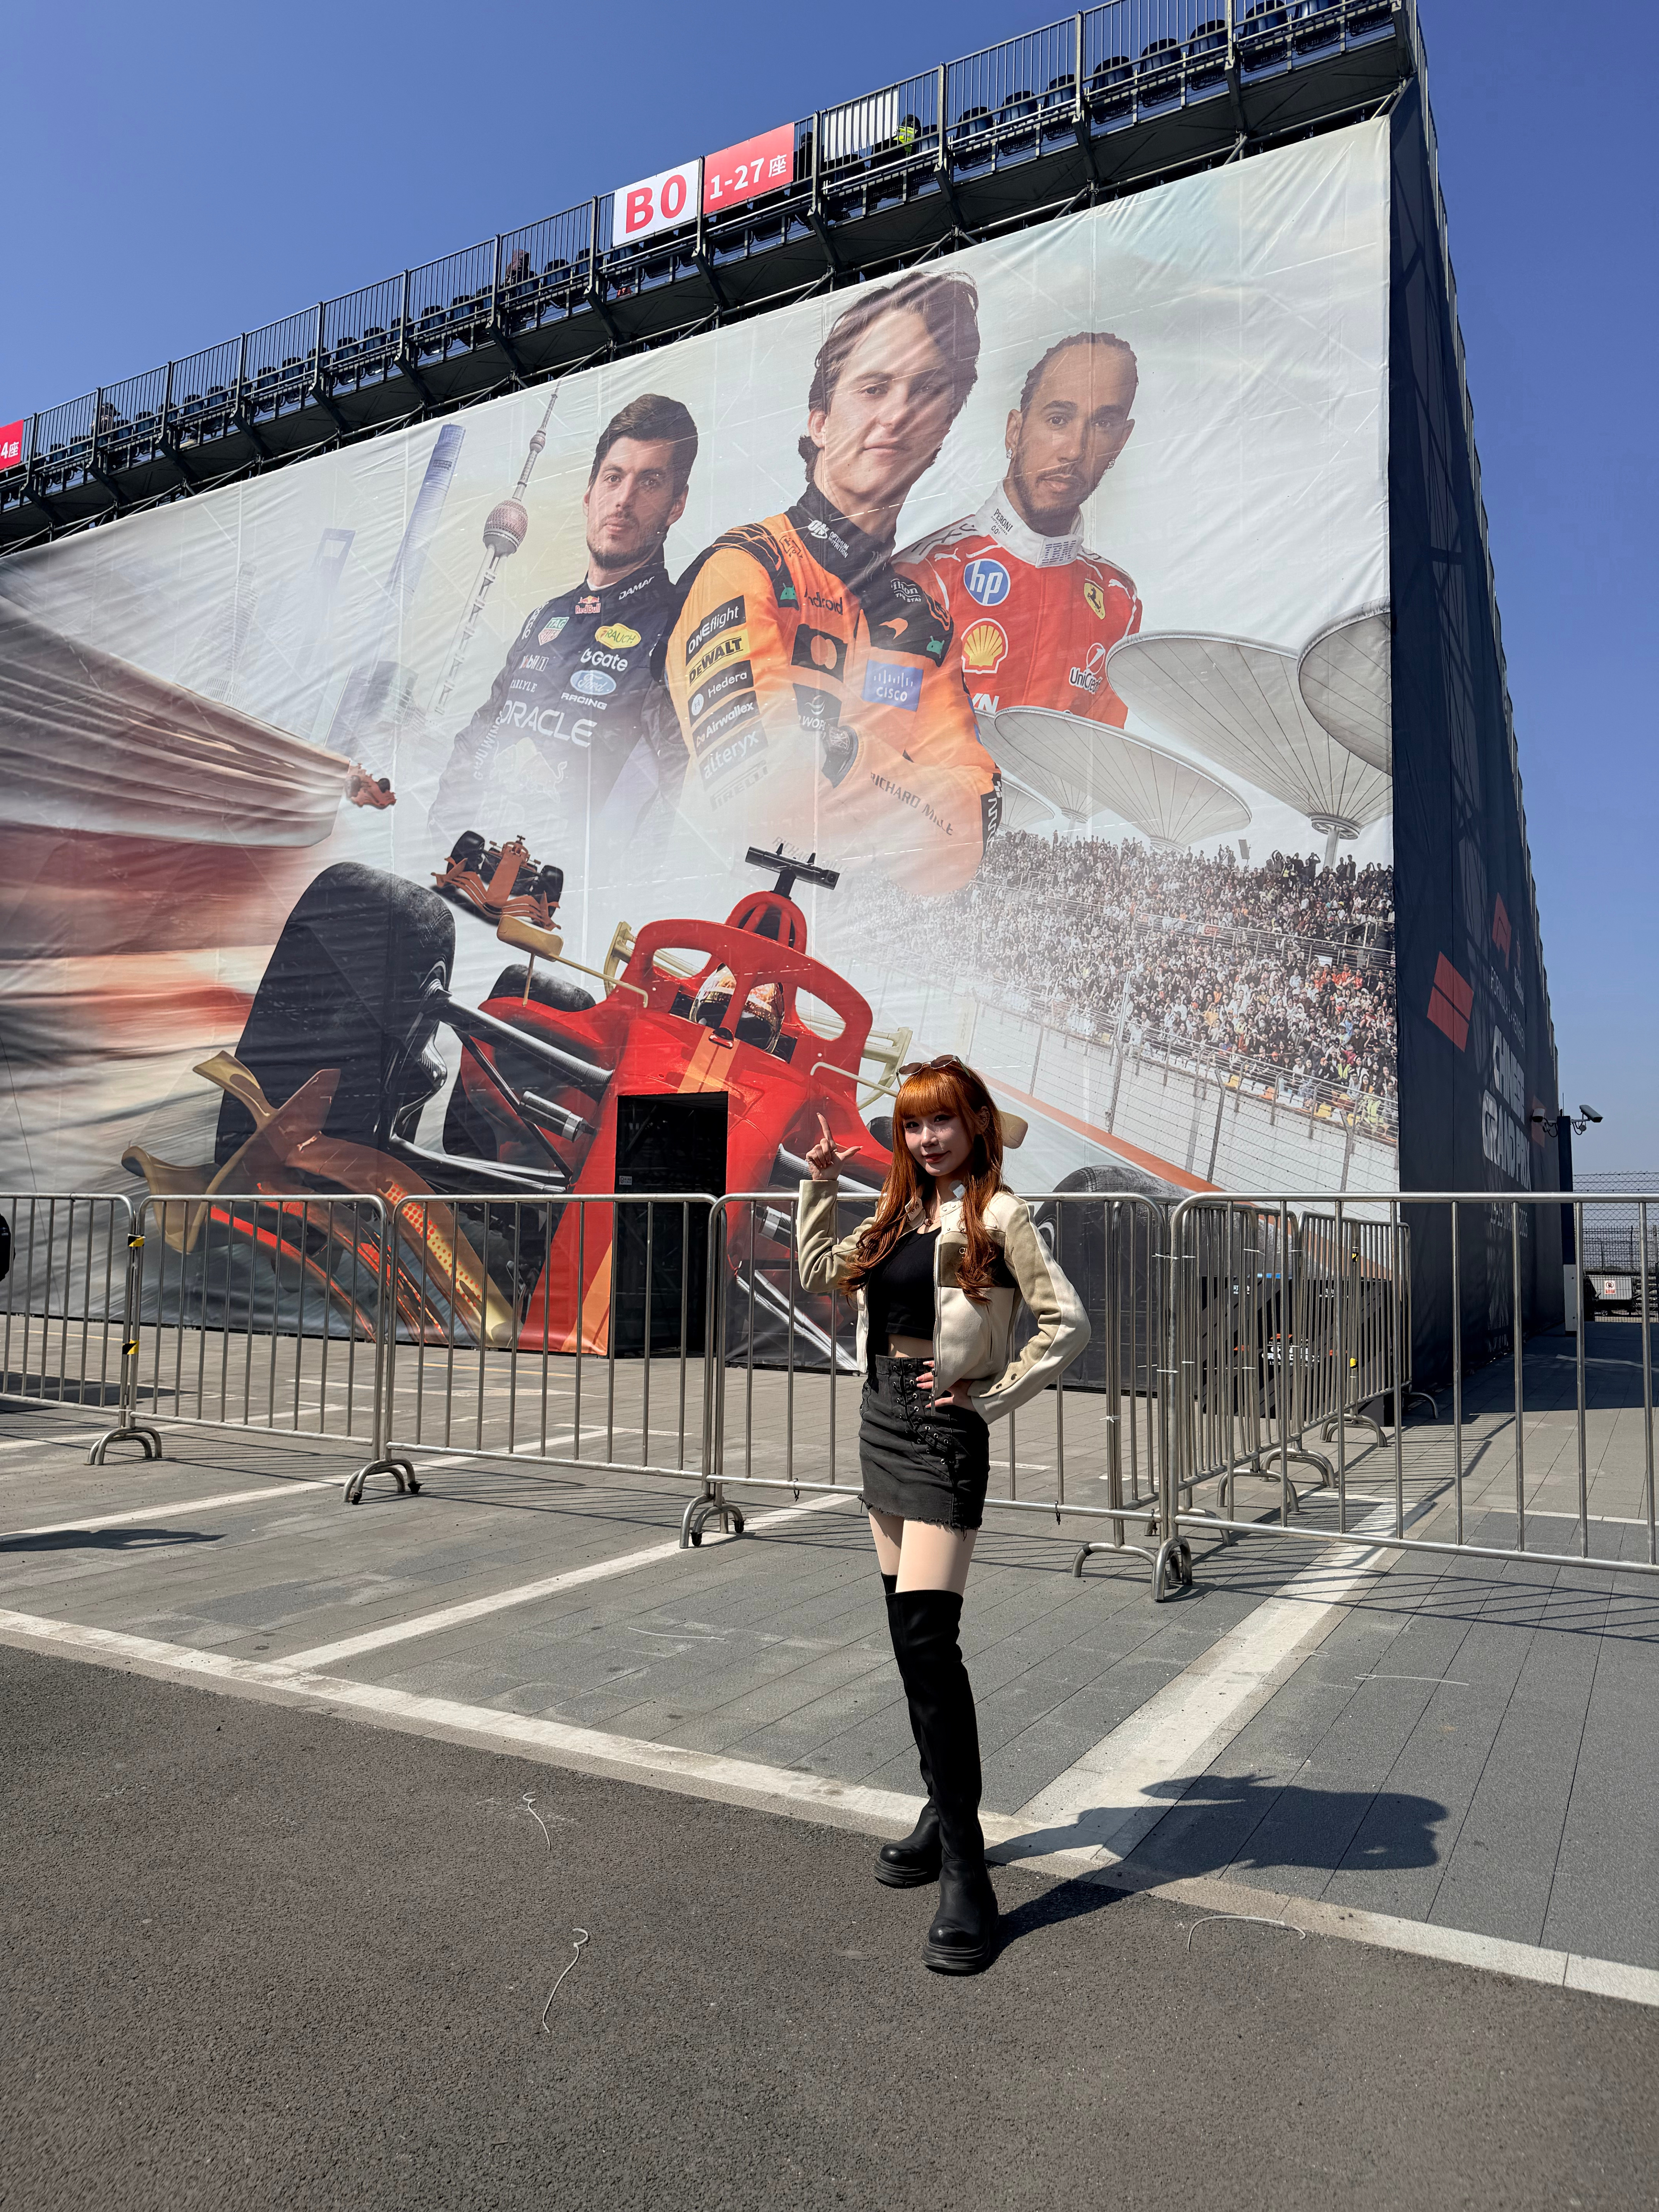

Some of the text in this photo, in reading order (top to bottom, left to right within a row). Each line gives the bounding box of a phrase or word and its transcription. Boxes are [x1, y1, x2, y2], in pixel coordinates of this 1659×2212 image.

[0, 441, 19, 459] 4座
[993, 508, 1013, 532] PERONI
[830, 531, 849, 551] OPTIMUM
[1042, 540, 1077, 563] IBM
[970, 561, 1003, 605] hp
[548, 619, 567, 628] TAG
[605, 629, 636, 644] RAUCH
[591, 651, 628, 672] Gate
[577, 673, 608, 692] Ford
[708, 671, 747, 698] Hedera
[1070, 668, 1101, 692] UniCred
[561, 692, 608, 710] RACING
[500, 700, 598, 748] ORACLE
[706, 701, 754, 738] Airwallex
[703, 731, 759, 779] alteryx
[710, 759, 769, 811] PIRELLI
[871, 772, 921, 809] RICHARD
[1493, 1025, 1525, 1125] CHINESE
[1482, 1089, 1532, 1192] GRAND PRIX
